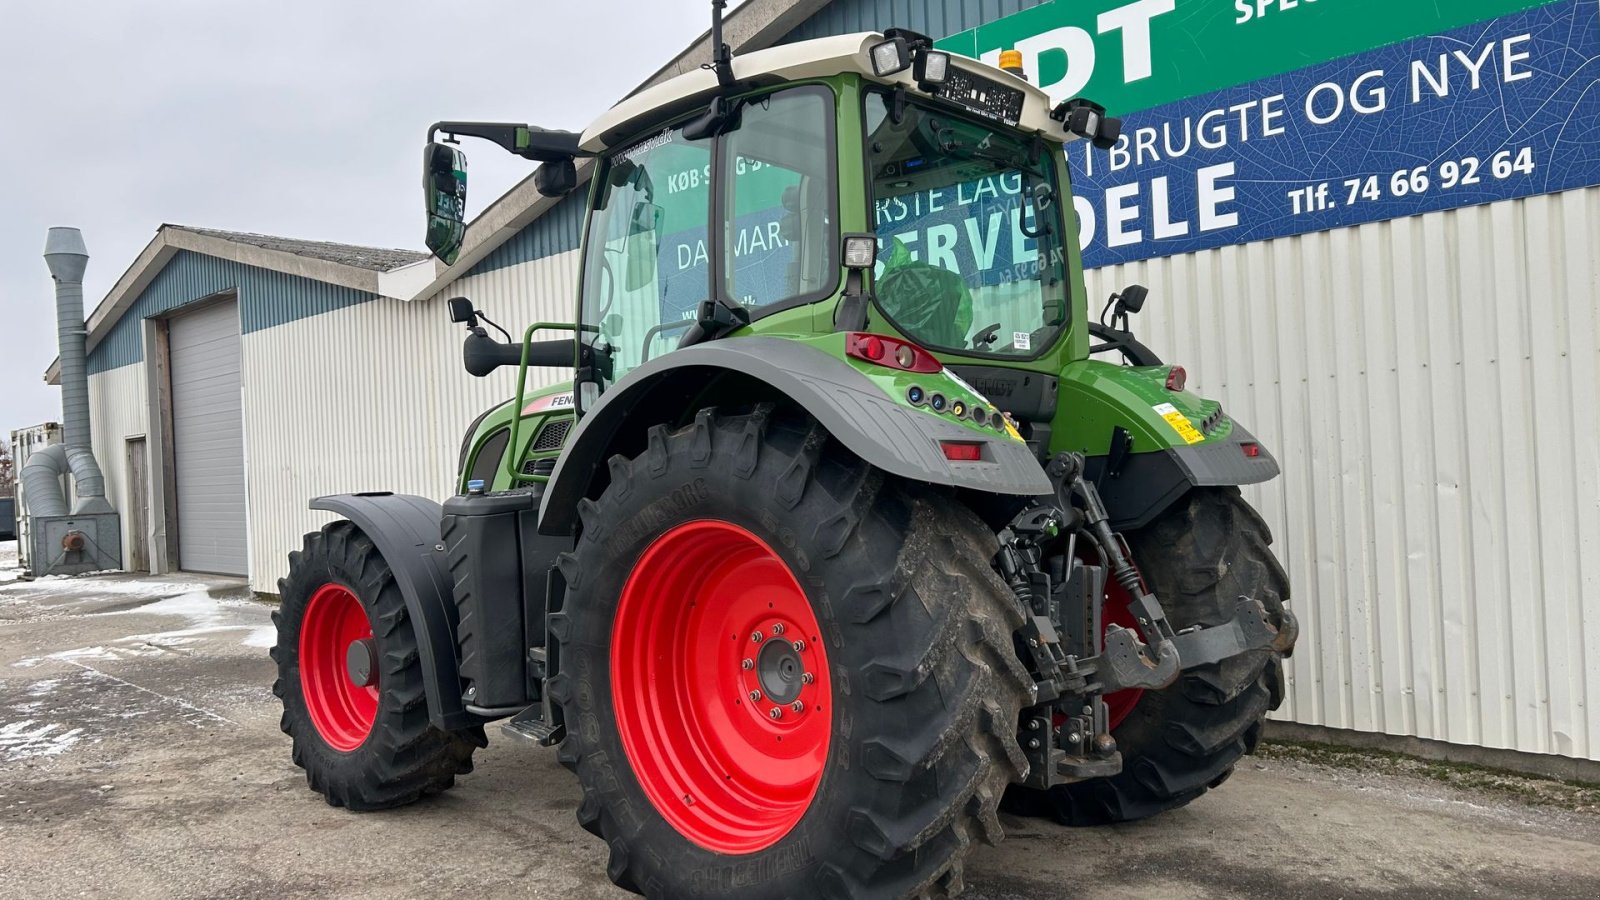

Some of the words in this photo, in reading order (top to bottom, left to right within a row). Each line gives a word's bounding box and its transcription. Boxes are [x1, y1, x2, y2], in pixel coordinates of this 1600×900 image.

[1110, 94, 1285, 172] BRUGTE
[1305, 70, 1386, 125] OG
[1411, 34, 1532, 103] NYE
[1288, 186, 1335, 215] Tlf.
[1344, 175, 1380, 206] 74
[1390, 166, 1429, 197] 66
[1440, 157, 1480, 189] 92
[1491, 147, 1535, 179] 64
[551, 394, 575, 407] FEN
